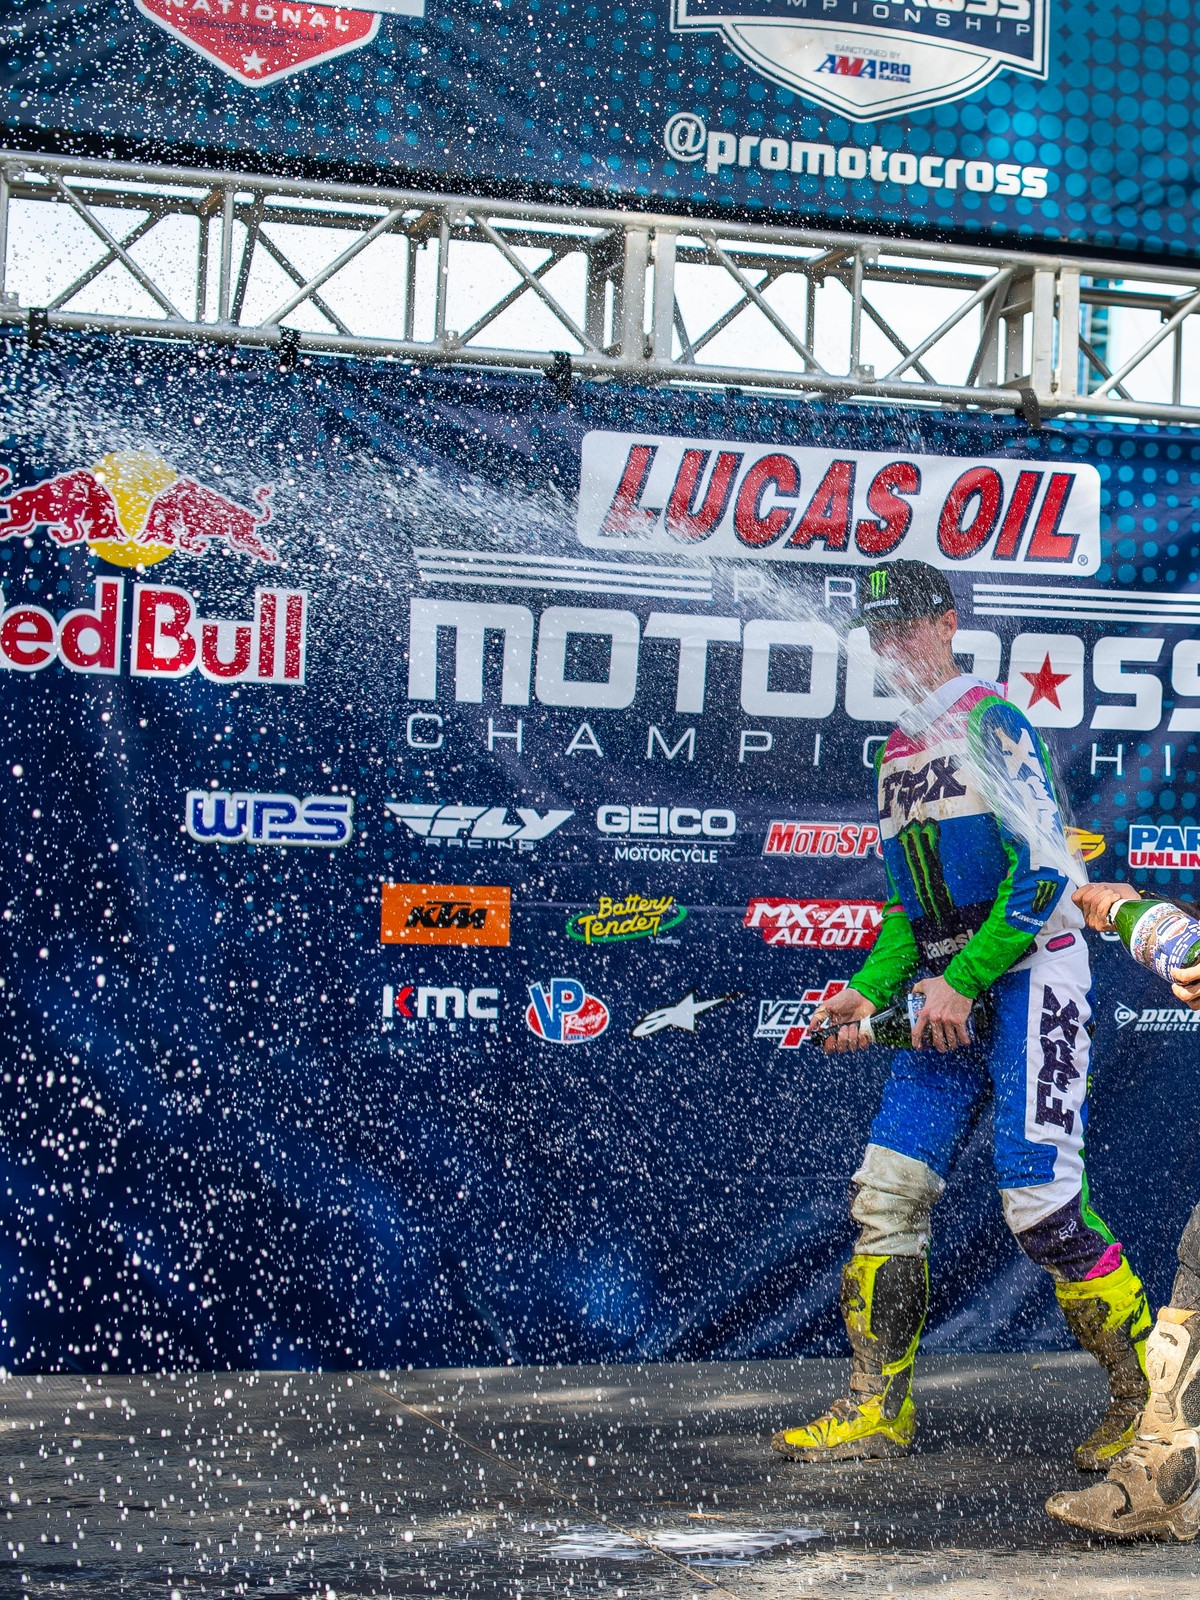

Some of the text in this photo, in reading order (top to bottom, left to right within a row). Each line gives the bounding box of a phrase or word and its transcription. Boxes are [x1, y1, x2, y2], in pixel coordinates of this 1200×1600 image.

[813, 53, 912, 80] AMA PRO
[663, 112, 1048, 199] @promotocross
[599, 443, 922, 558] LUCAS
[733, 568, 857, 611] PR
[0, 579, 306, 683] ed Bull
[188, 792, 353, 846] WPS
[385, 803, 575, 840] FLY
[597, 805, 737, 837] GEICO
[425, 838, 535, 851] RACING
[614, 847, 719, 864] MOTORCYCLE
[404, 901, 488, 930] KTM
[597, 894, 675, 919] Battery
[747, 902, 820, 928] MX
[577, 915, 660, 945] Tender
[766, 928, 870, 946] ALL OUT
[382, 986, 499, 1019] KMC
[528, 978, 586, 1042] VP
[383, 1022, 499, 1033] WHEELS
[1135, 1022, 1198, 1032] MOTORCYCLE
